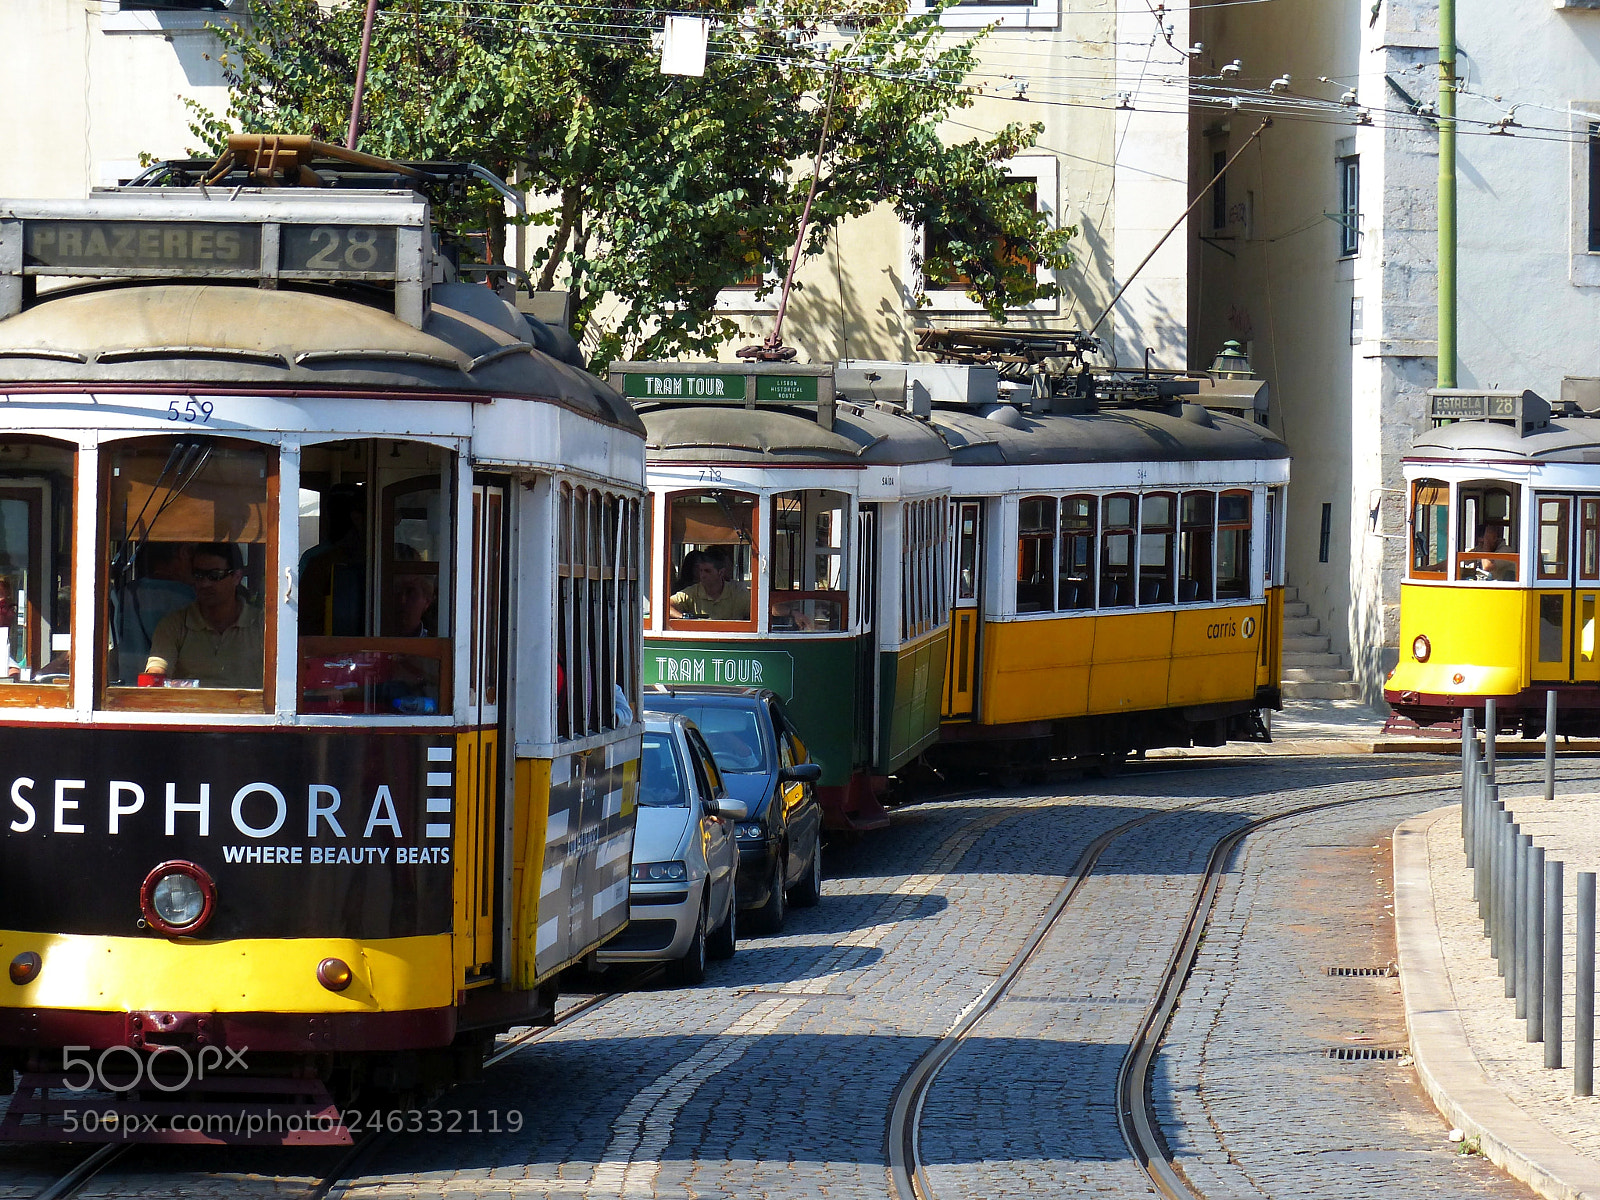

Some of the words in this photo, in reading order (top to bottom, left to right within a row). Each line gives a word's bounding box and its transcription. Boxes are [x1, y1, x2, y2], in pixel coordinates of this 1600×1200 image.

[32, 227, 240, 259] PRAZERES
[305, 226, 378, 269] 28
[644, 376, 682, 396] TRAM
[687, 377, 725, 396] TOUR
[167, 400, 215, 423] 559
[1436, 397, 1482, 409] ESTRELA
[1495, 397, 1513, 414] 28
[698, 470, 722, 482] 713
[1207, 616, 1236, 639] carris
[655, 656, 705, 682] TRAM
[712, 658, 763, 683] TOUR
[9, 776, 403, 839] SEPHORA
[222, 845, 302, 864] WHERE
[310, 846, 389, 865] BEAUTY
[396, 846, 450, 865] BEATS
